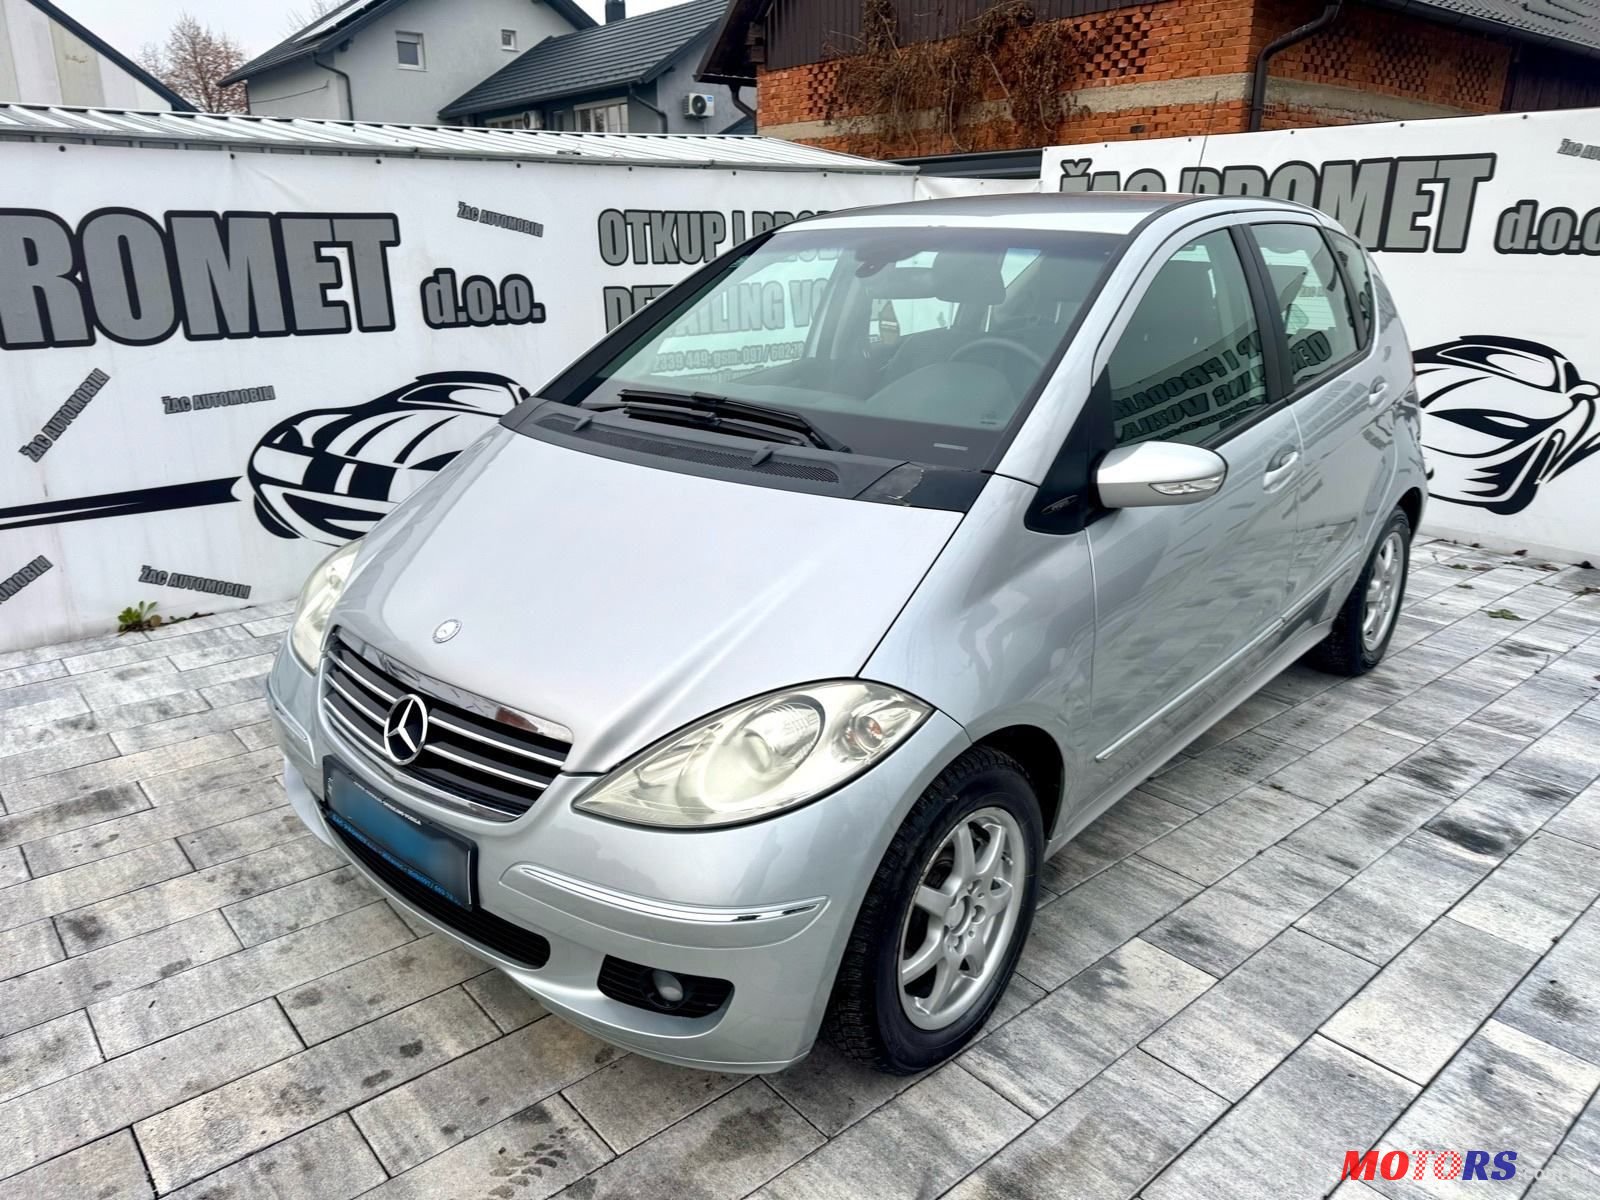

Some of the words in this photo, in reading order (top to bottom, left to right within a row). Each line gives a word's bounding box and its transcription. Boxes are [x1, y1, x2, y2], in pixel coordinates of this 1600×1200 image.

[456, 200, 480, 222] ŽAC
[479, 208, 544, 238] AUTOMOBILI
[597, 208, 727, 267] OTKUP
[420, 268, 546, 330] d.o.o.
[18, 433, 53, 463] ŽAC
[41, 367, 111, 441] AUTOMOBILI
[161, 395, 192, 415] ŽAC
[192, 385, 276, 411] AUTOMOBILI
[138, 564, 168, 586] ŽAC
[168, 572, 252, 600] AUTOMOBILI
